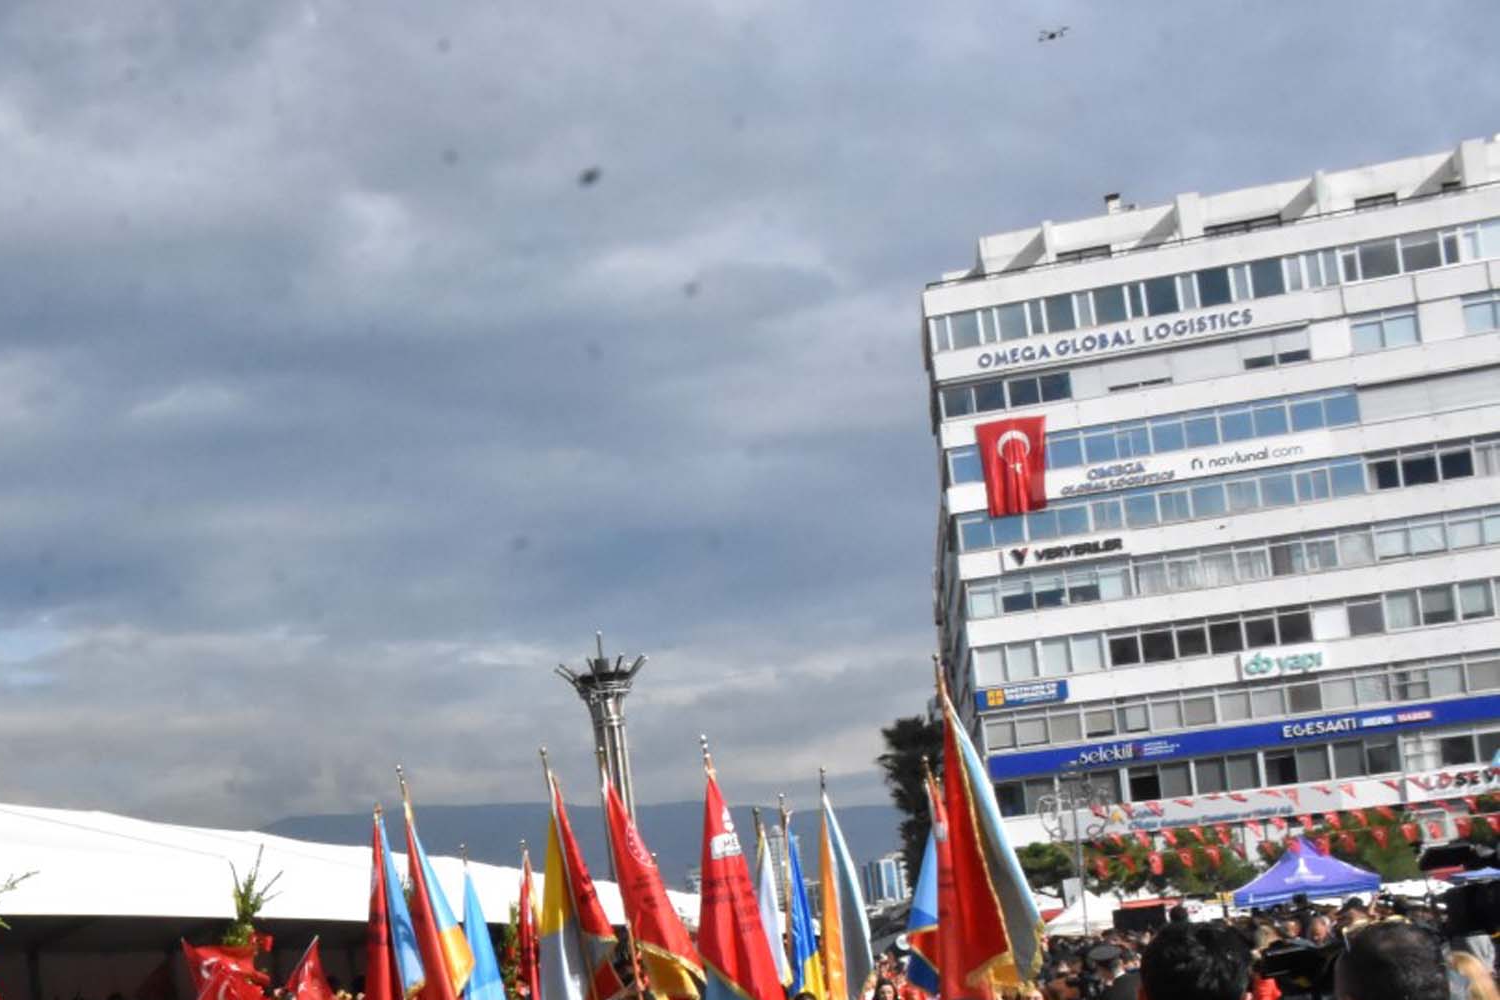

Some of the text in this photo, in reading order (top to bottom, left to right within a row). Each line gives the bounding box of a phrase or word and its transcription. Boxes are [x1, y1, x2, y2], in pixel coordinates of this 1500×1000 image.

[977, 308, 1253, 369] OMEGA GLOBAL LOGISTICS
